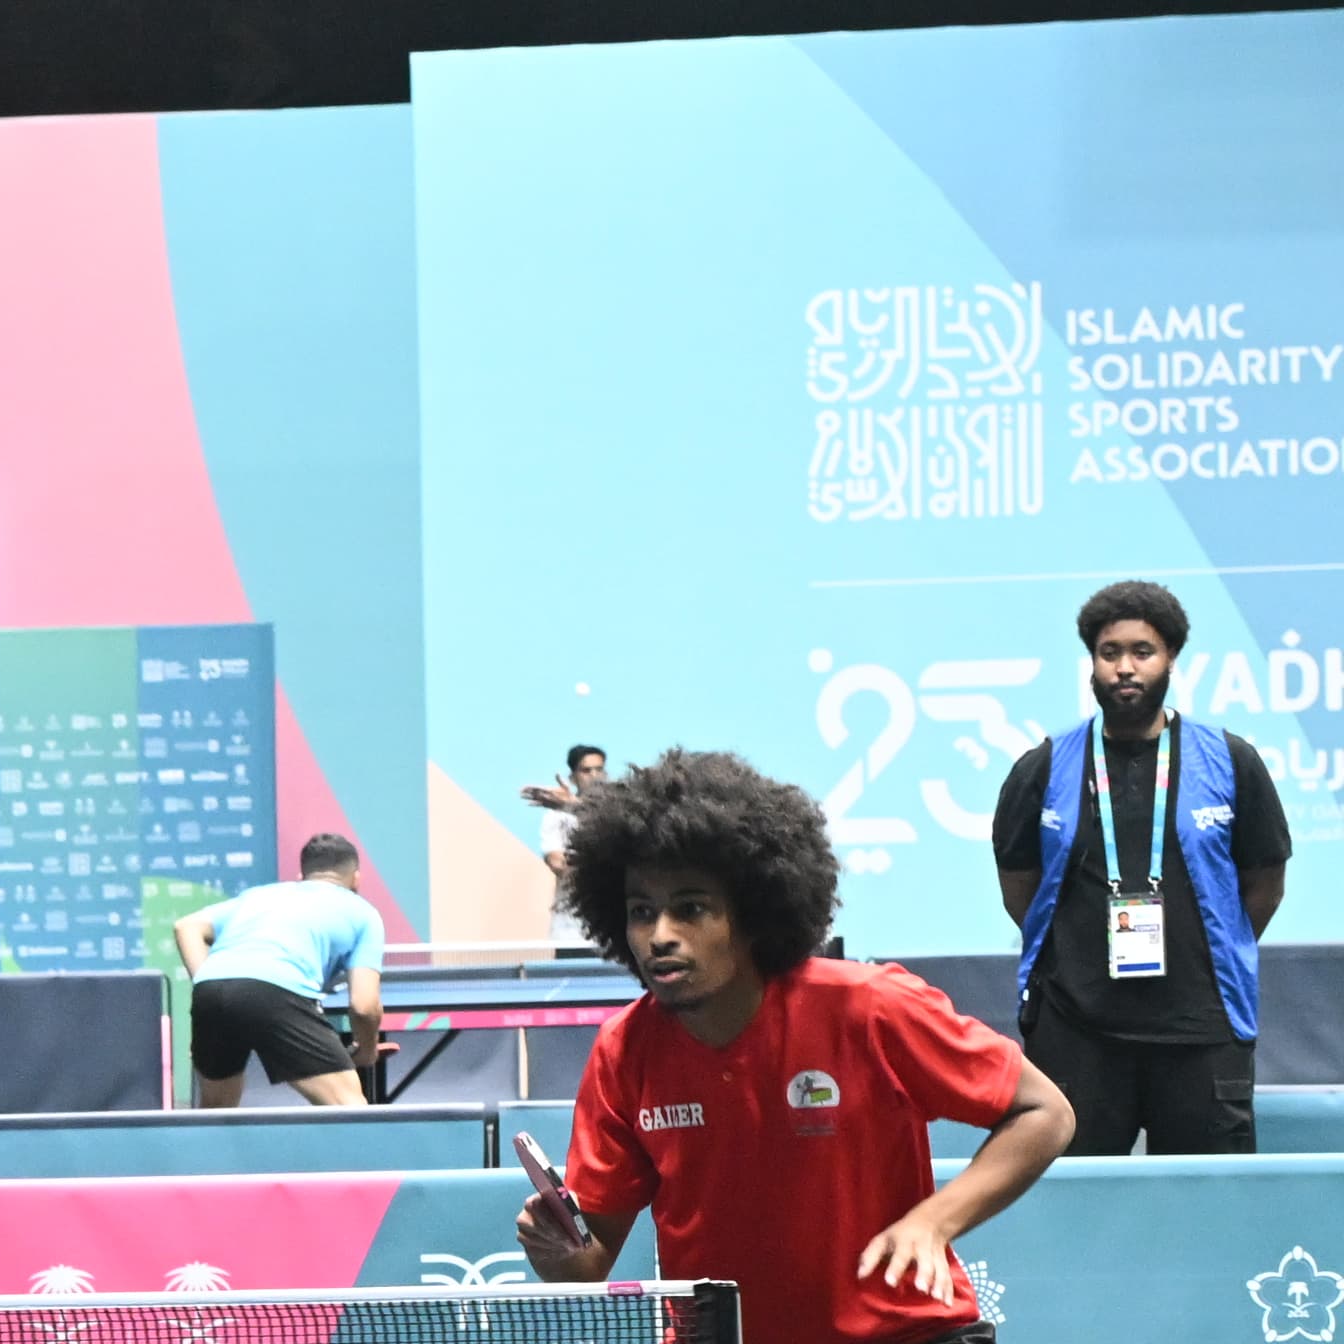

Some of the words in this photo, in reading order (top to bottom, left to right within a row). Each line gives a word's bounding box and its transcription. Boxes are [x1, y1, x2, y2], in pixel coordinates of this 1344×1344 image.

[1066, 303, 1245, 346] ISLAMIC
[1068, 344, 1343, 391] SOLIDARITY
[1068, 396, 1239, 437] SPORTS
[1069, 437, 1344, 484] ASSOCIATIO
[810, 650, 1045, 868] 25
